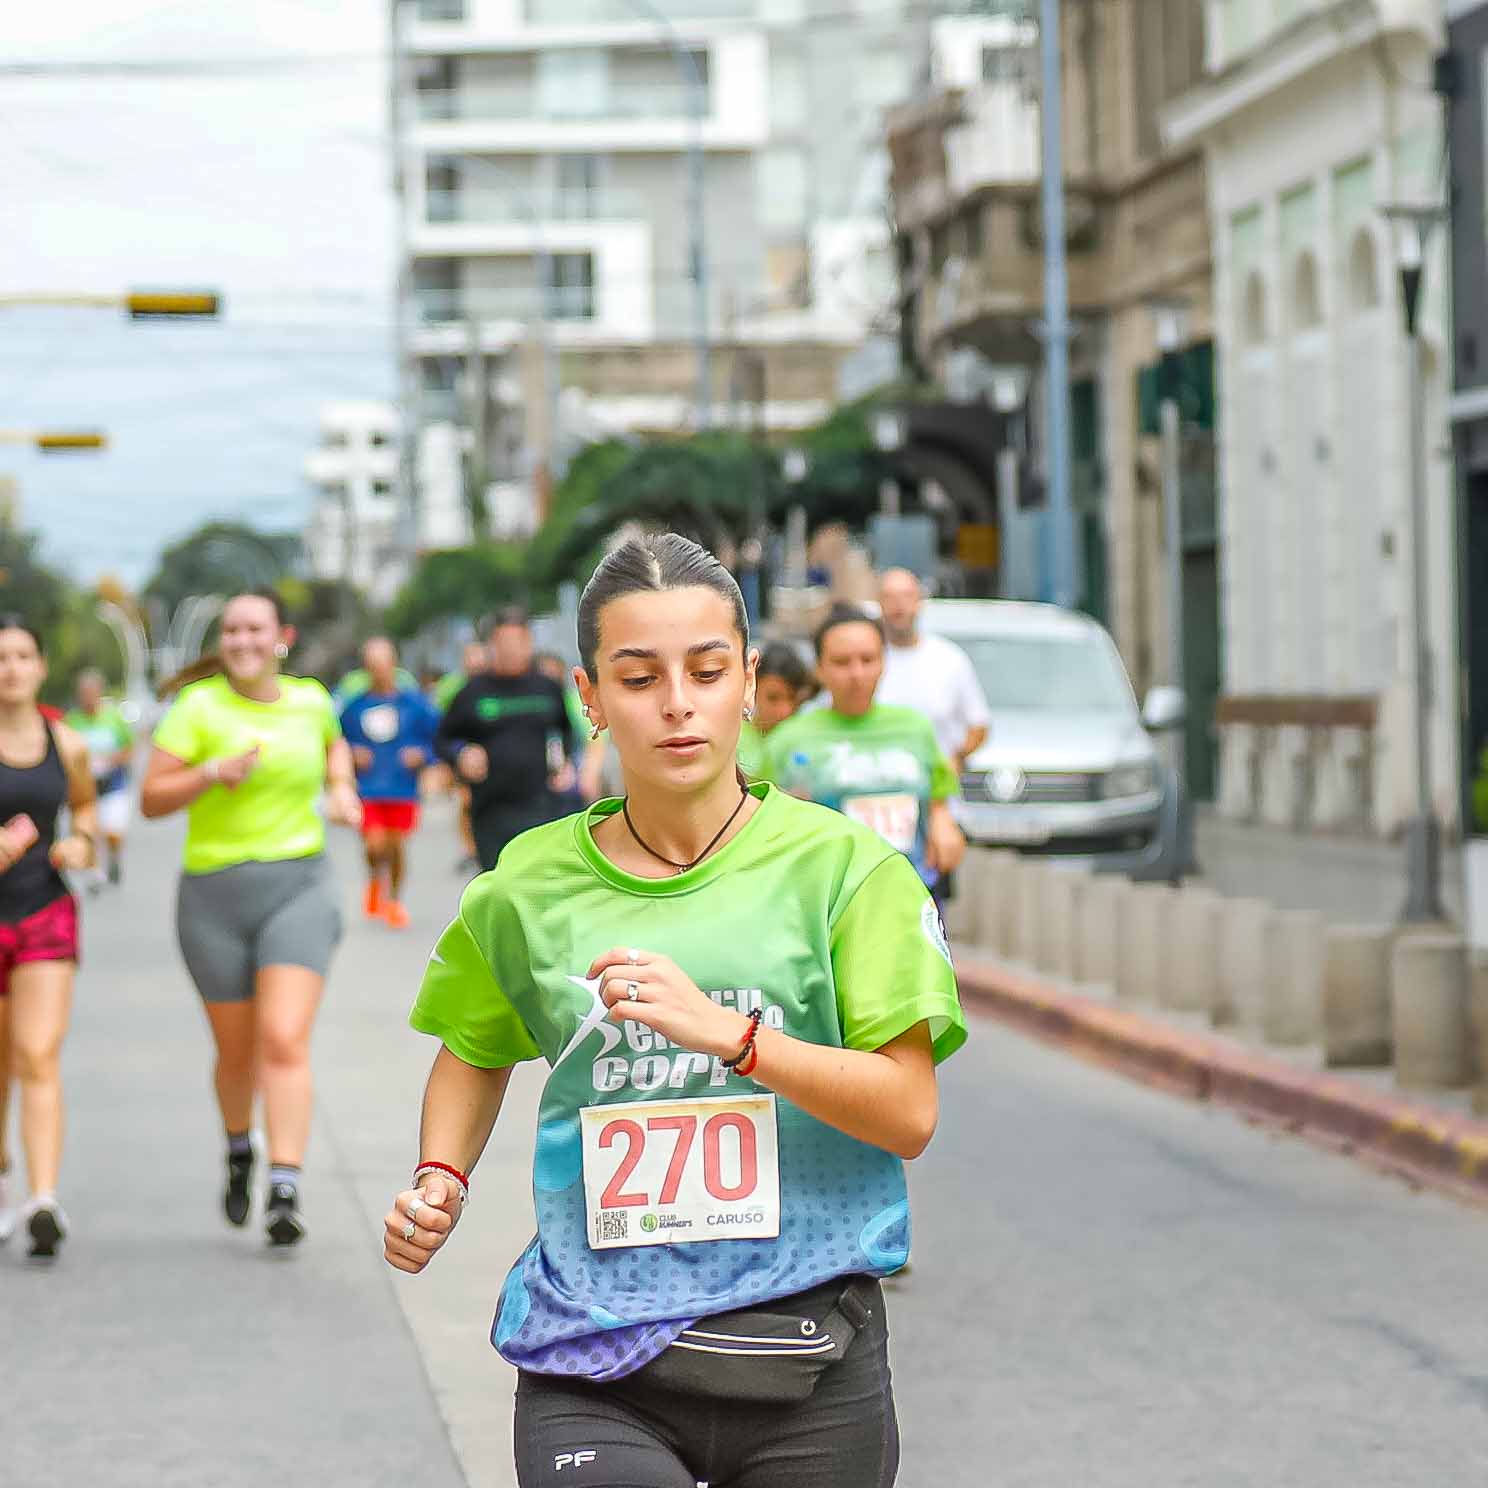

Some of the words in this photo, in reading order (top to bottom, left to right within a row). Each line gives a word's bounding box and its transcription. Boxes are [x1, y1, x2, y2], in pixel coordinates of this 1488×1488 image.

[599, 1112, 758, 1209] 270
[706, 1213, 764, 1226] CARUSO
[555, 1450, 597, 1471] PF
